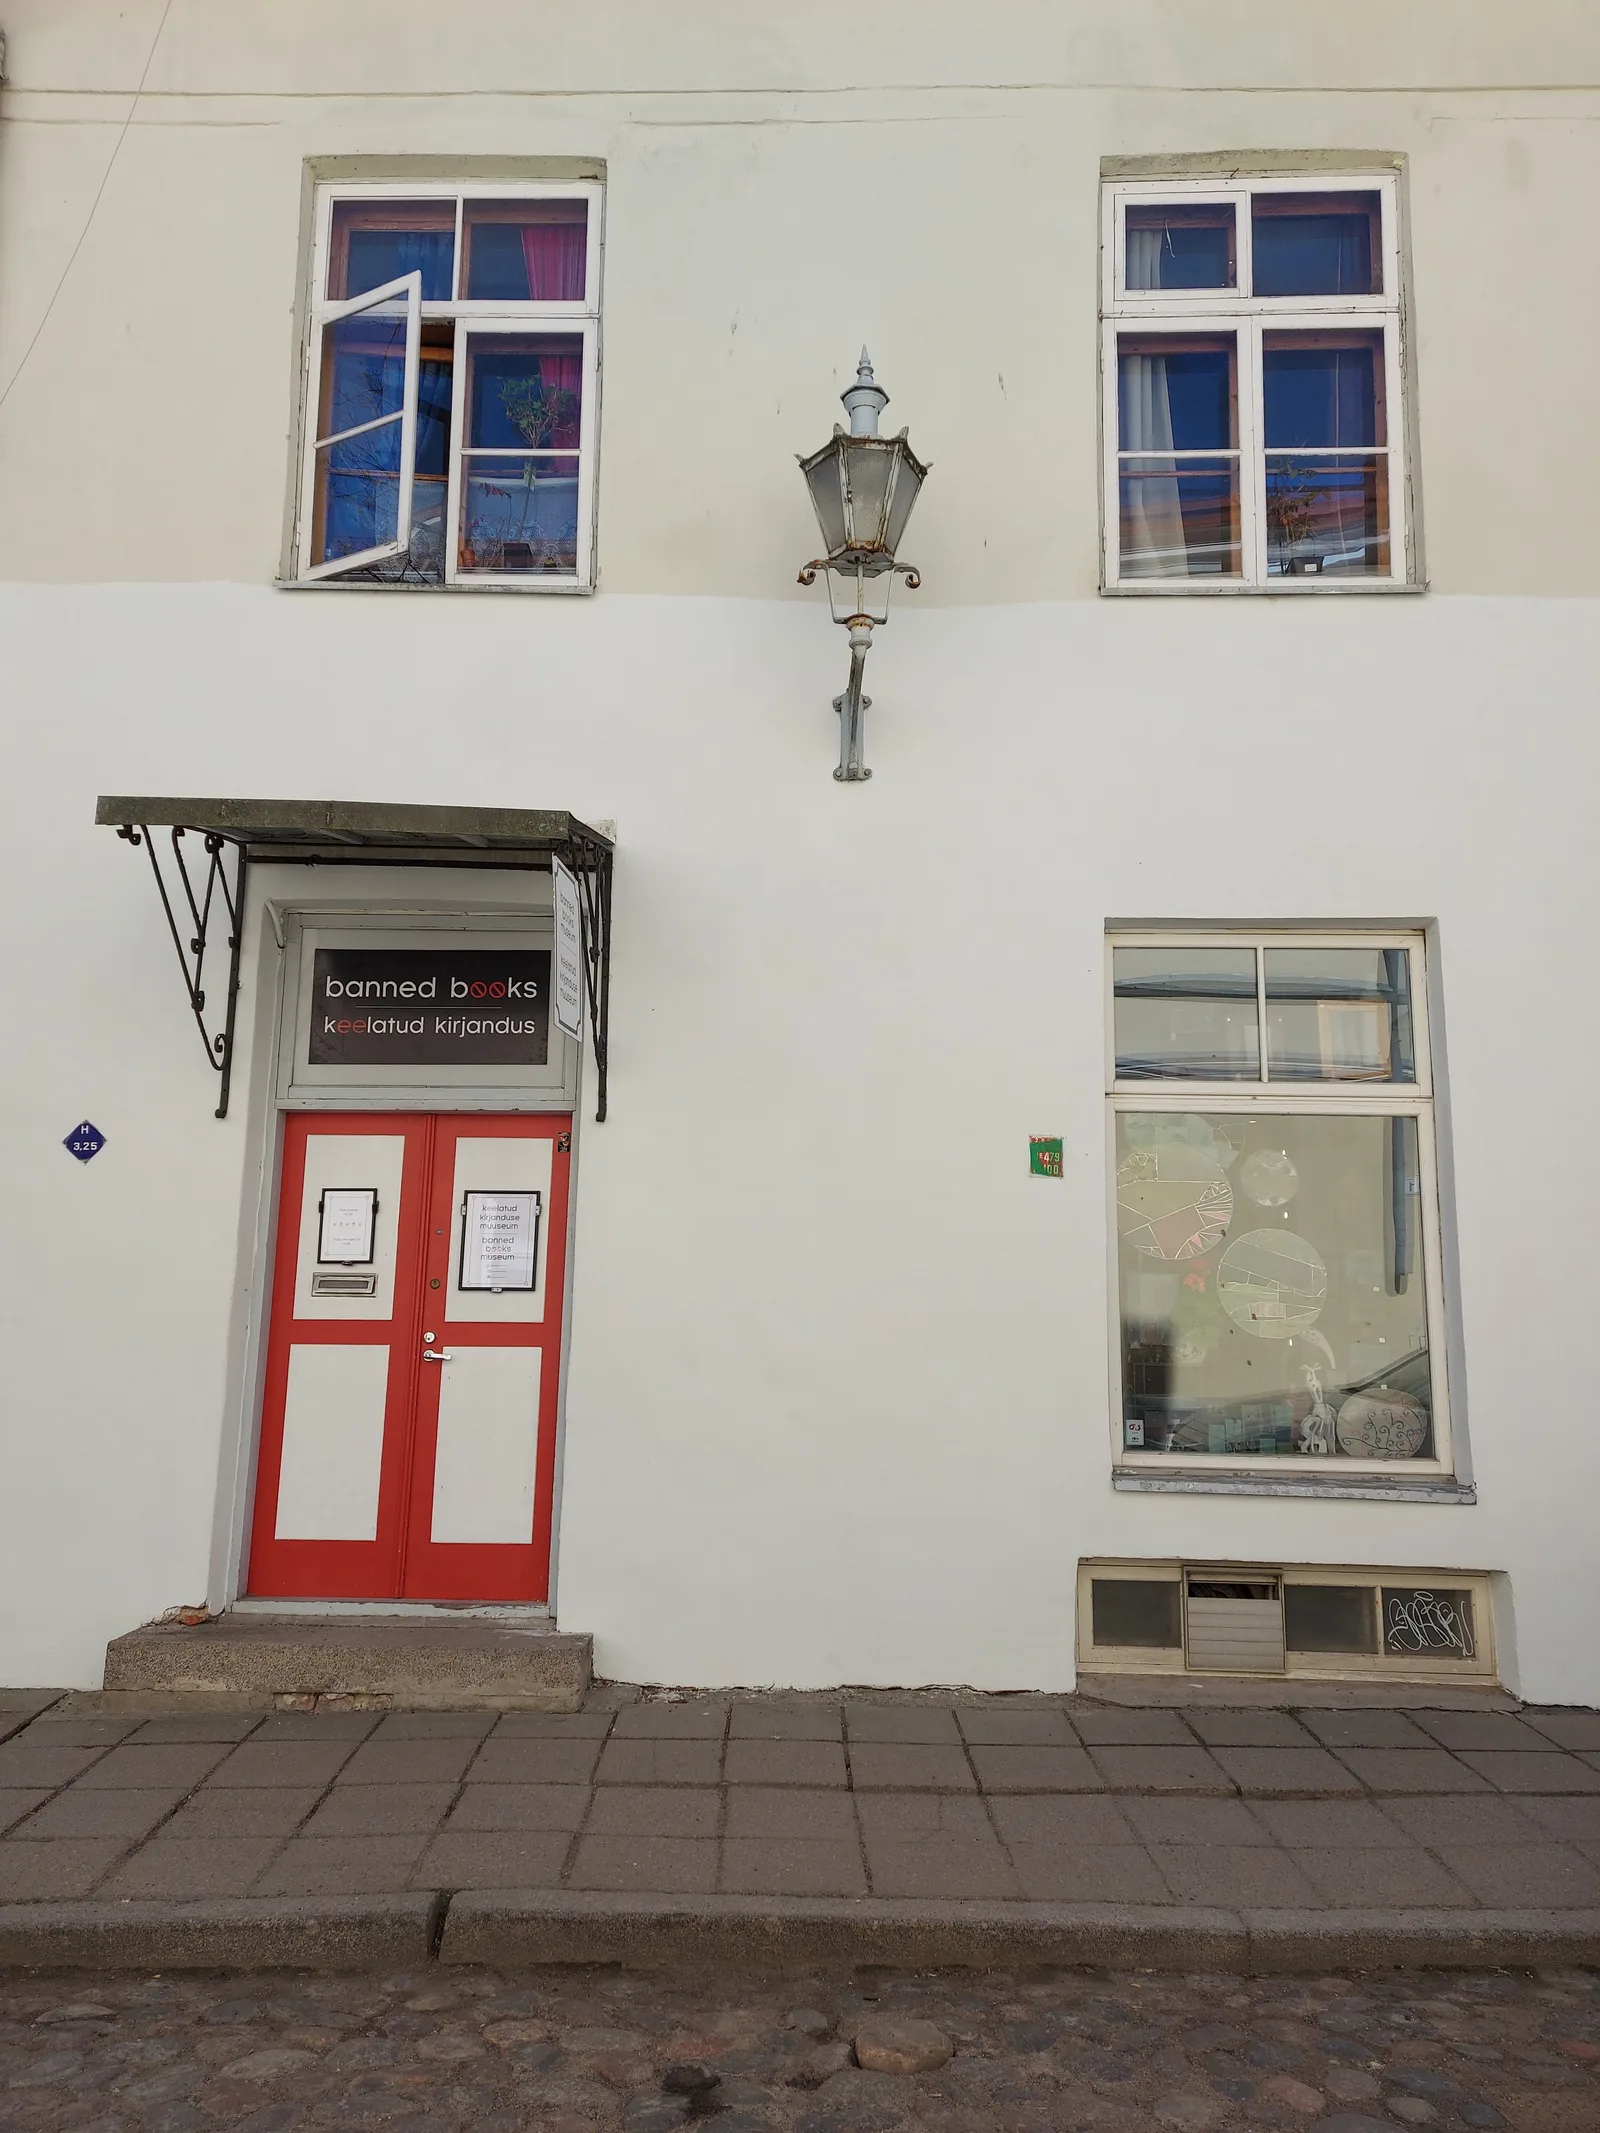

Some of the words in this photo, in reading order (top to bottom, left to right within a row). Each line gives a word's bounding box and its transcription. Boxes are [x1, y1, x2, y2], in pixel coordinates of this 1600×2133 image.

[325, 975, 437, 999] banned
[450, 976, 538, 999] books
[323, 1016, 424, 1034] keelatud
[434, 1016, 535, 1038] kirjandus
[81, 1125, 89, 1134] H
[73, 1142, 98, 1151] 3,25
[482, 1204, 518, 1212] keelatud
[479, 1214, 520, 1222] kirjanduse
